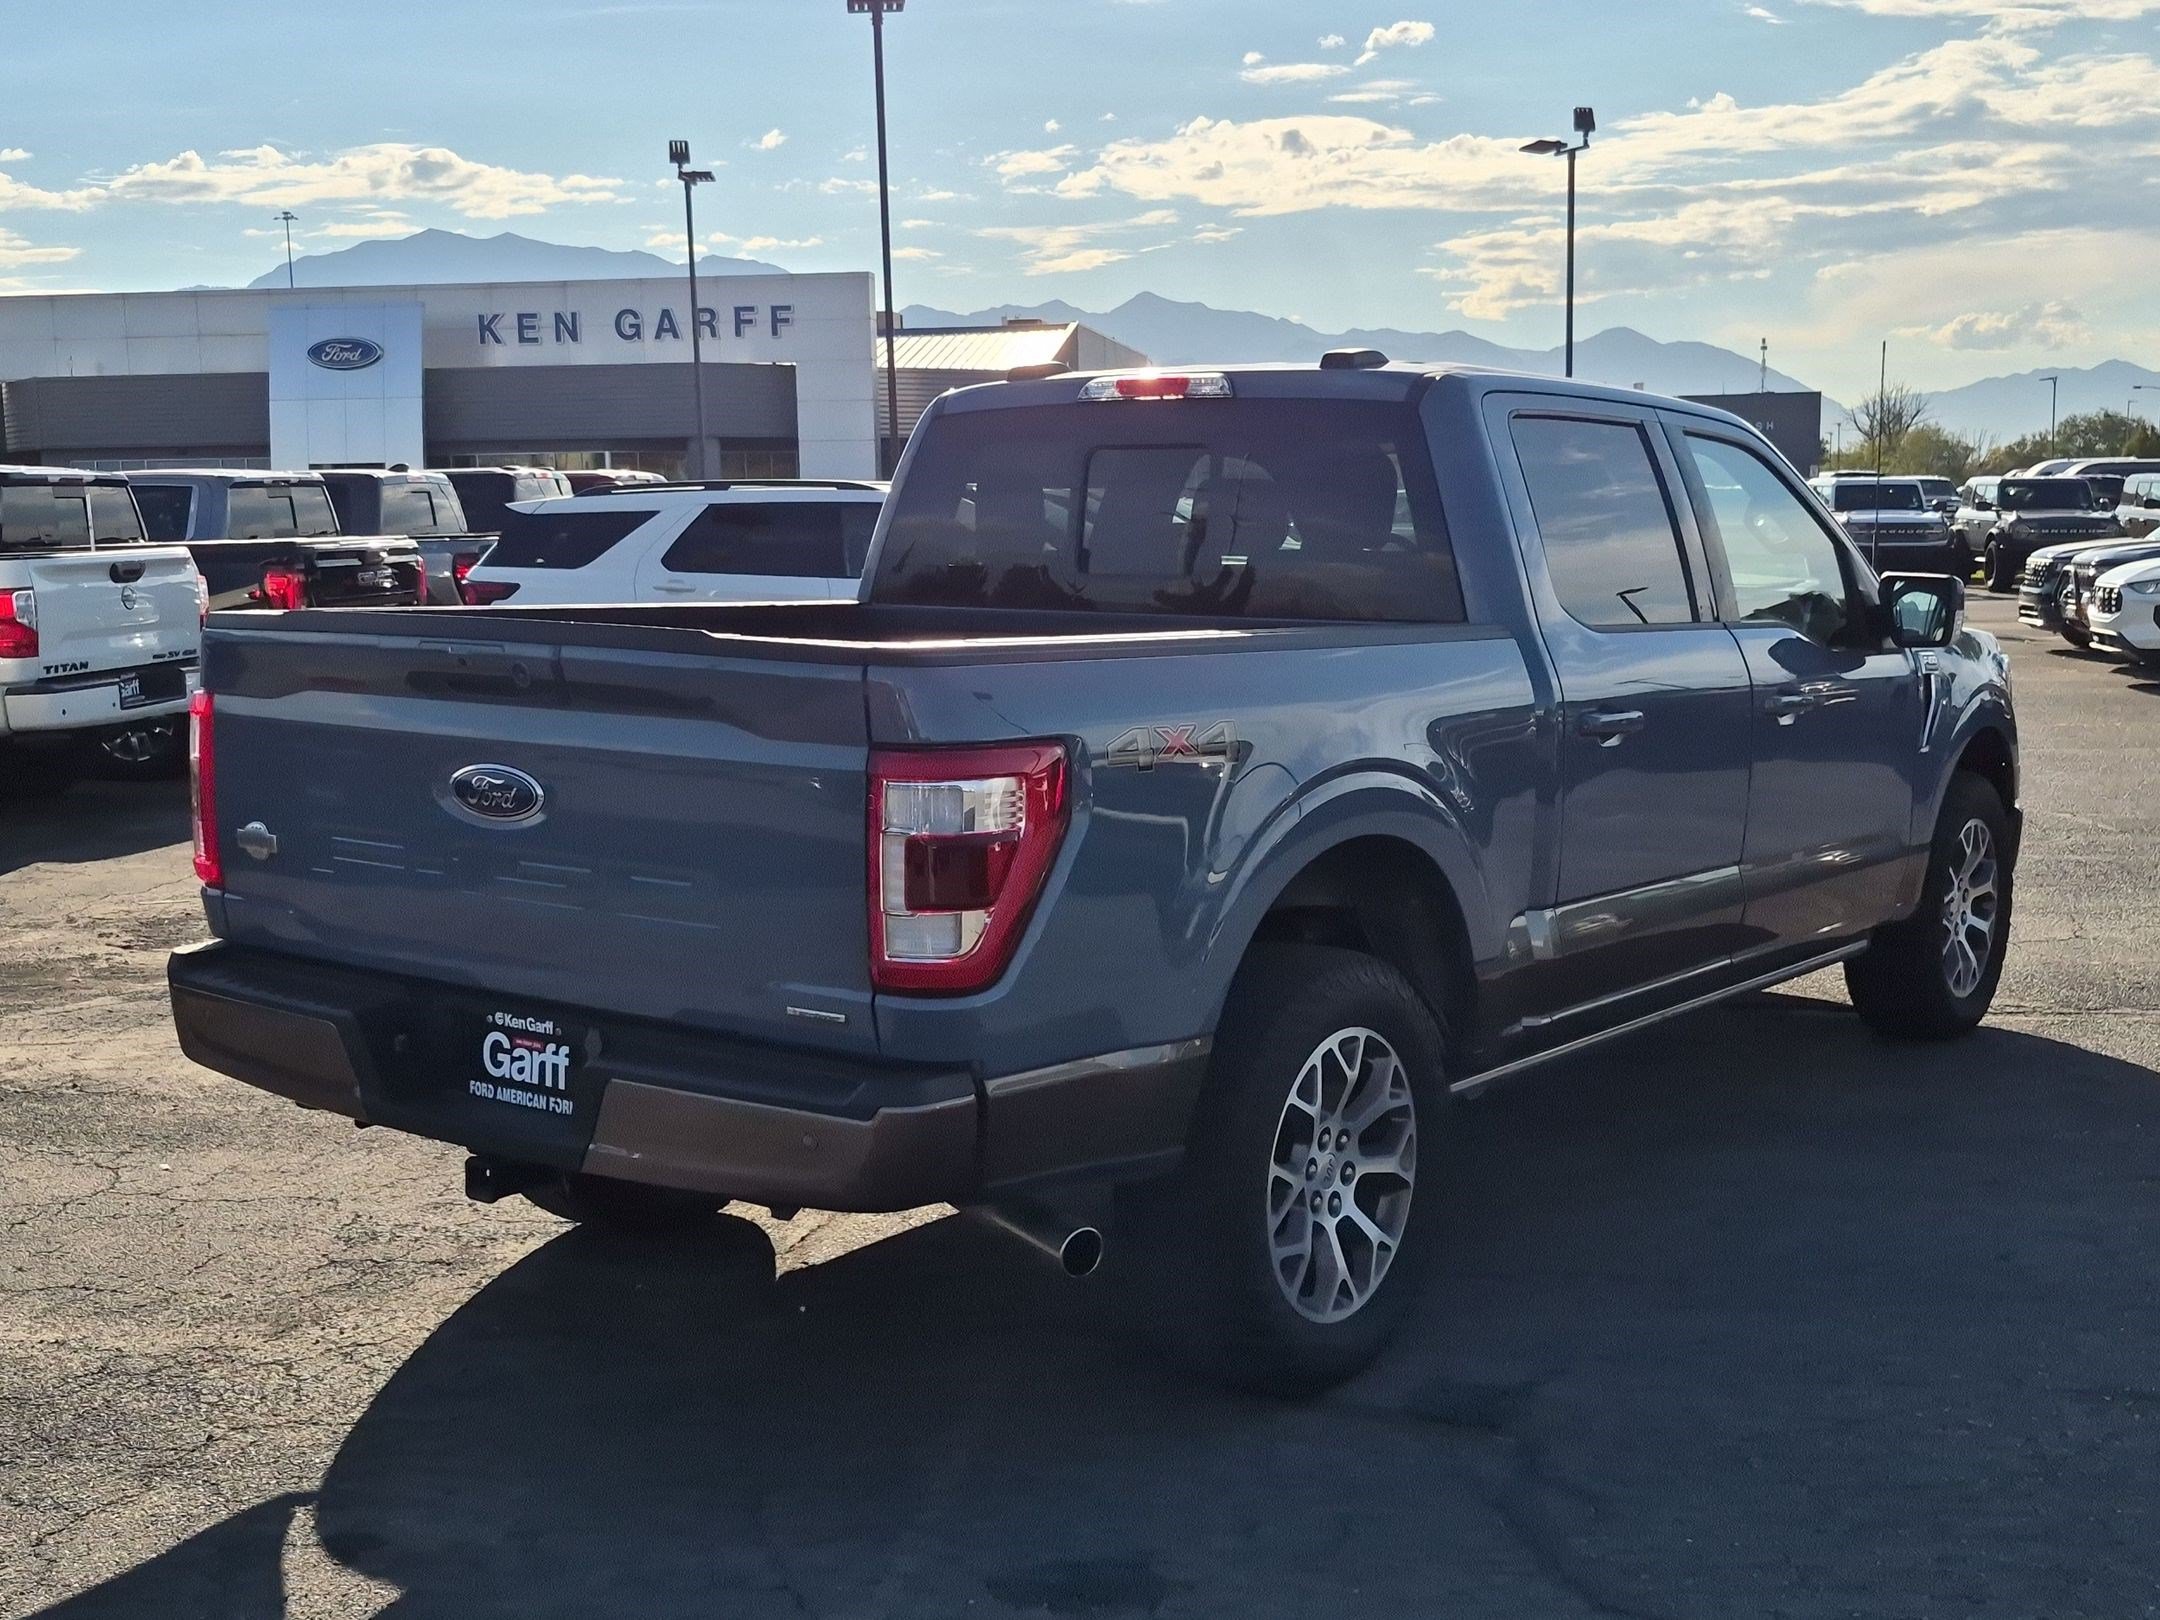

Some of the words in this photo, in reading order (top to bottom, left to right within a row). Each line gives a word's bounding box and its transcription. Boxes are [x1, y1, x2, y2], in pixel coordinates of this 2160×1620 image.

[477, 311, 580, 345] KEN
[614, 305, 793, 341] GARFF
[321, 343, 362, 361] Ford
[43, 661, 89, 675] TITAN
[467, 775, 517, 809] Ford
[504, 1013, 526, 1030] Ken
[526, 1017, 554, 1035] Garff
[483, 1031, 570, 1090] Garff
[469, 1080, 495, 1099] FORD
[496, 1086, 547, 1110] AMERICAN
